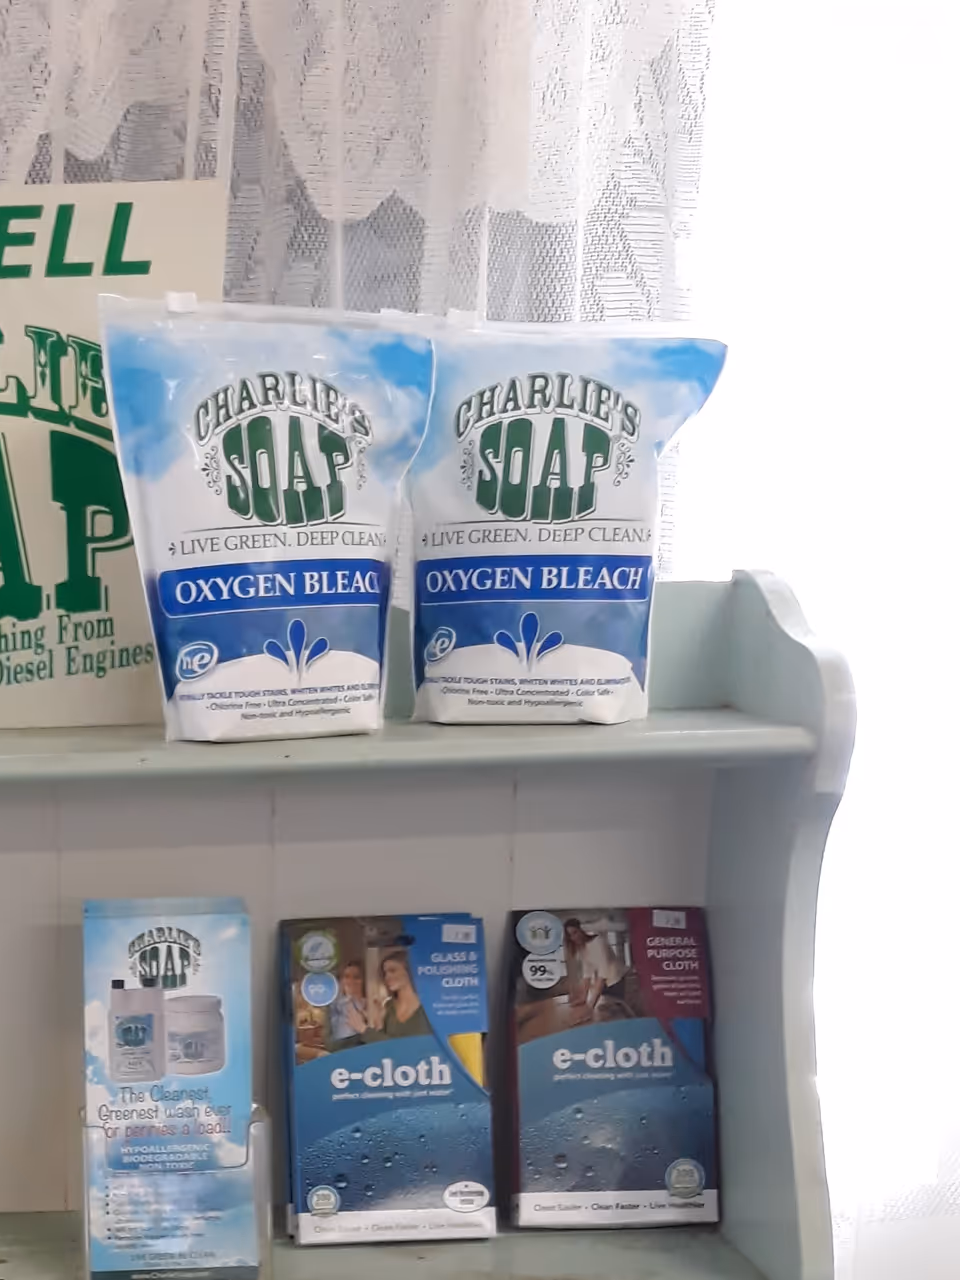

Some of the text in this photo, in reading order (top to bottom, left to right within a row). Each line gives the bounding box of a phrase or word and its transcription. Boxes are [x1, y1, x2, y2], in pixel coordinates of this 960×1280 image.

[194, 371, 374, 446] CHARLIE'S
[455, 372, 641, 443] CHARLIE'S
[222, 415, 351, 526] SOAP
[476, 417, 611, 523] SOAP
[180, 536, 224, 555] LIVE
[297, 531, 339, 547] DEEP
[431, 529, 465, 547] LIVE
[538, 526, 585, 543] DEEP
[175, 574, 296, 604] OXYGEN
[426, 565, 644, 593] OXYGEN BLEACH
[57, 614, 115, 648] From
[66, 643, 155, 682] Engines
[646, 936, 697, 947] GENERAL
[646, 948, 697, 959] PURPOSE
[139, 944, 192, 989] SOAP
[417, 965, 478, 976] POLISHING
[431, 952, 467, 963] GLASS
[662, 960, 699, 971] CLOTH
[442, 977, 479, 988] CLOTH
[552, 1038, 674, 1071] e-cloth
[330, 1055, 452, 1090] e-cloth
[120, 1084, 209, 1104] The Cleanest
[98, 1101, 232, 1121] Greenest wash ever
[122, 1153, 208, 1164] BIODEGRADABLE
